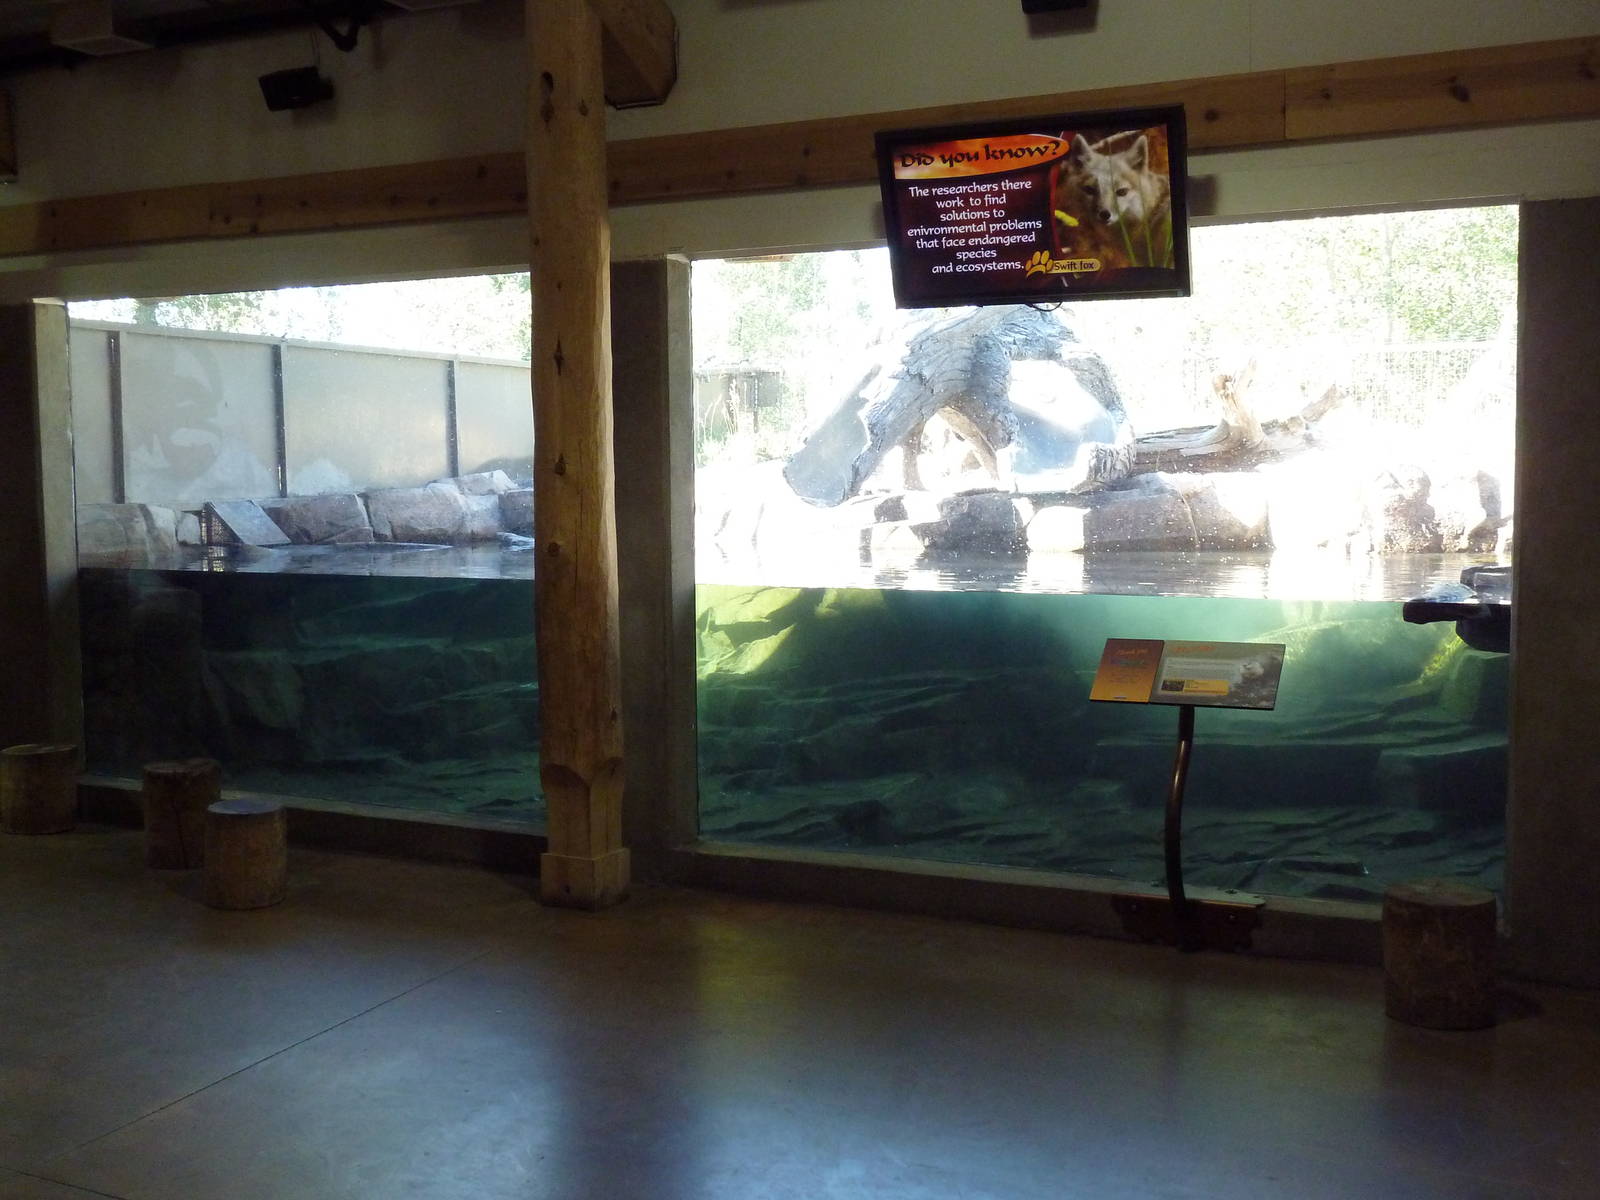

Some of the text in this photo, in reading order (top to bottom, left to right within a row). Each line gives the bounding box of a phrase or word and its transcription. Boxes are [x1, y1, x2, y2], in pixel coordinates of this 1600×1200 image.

[901, 140, 1060, 168] Did you know?
[908, 179, 1032, 197] The researchers there
[936, 194, 1006, 208] work to find
[940, 208, 1005, 222] solutions to
[989, 219, 1042, 233] problems
[916, 232, 1036, 249] that face endangered
[956, 249, 997, 262] species
[932, 260, 1024, 274] and ecosystems.
[1054, 261, 1095, 271] Swift fox
